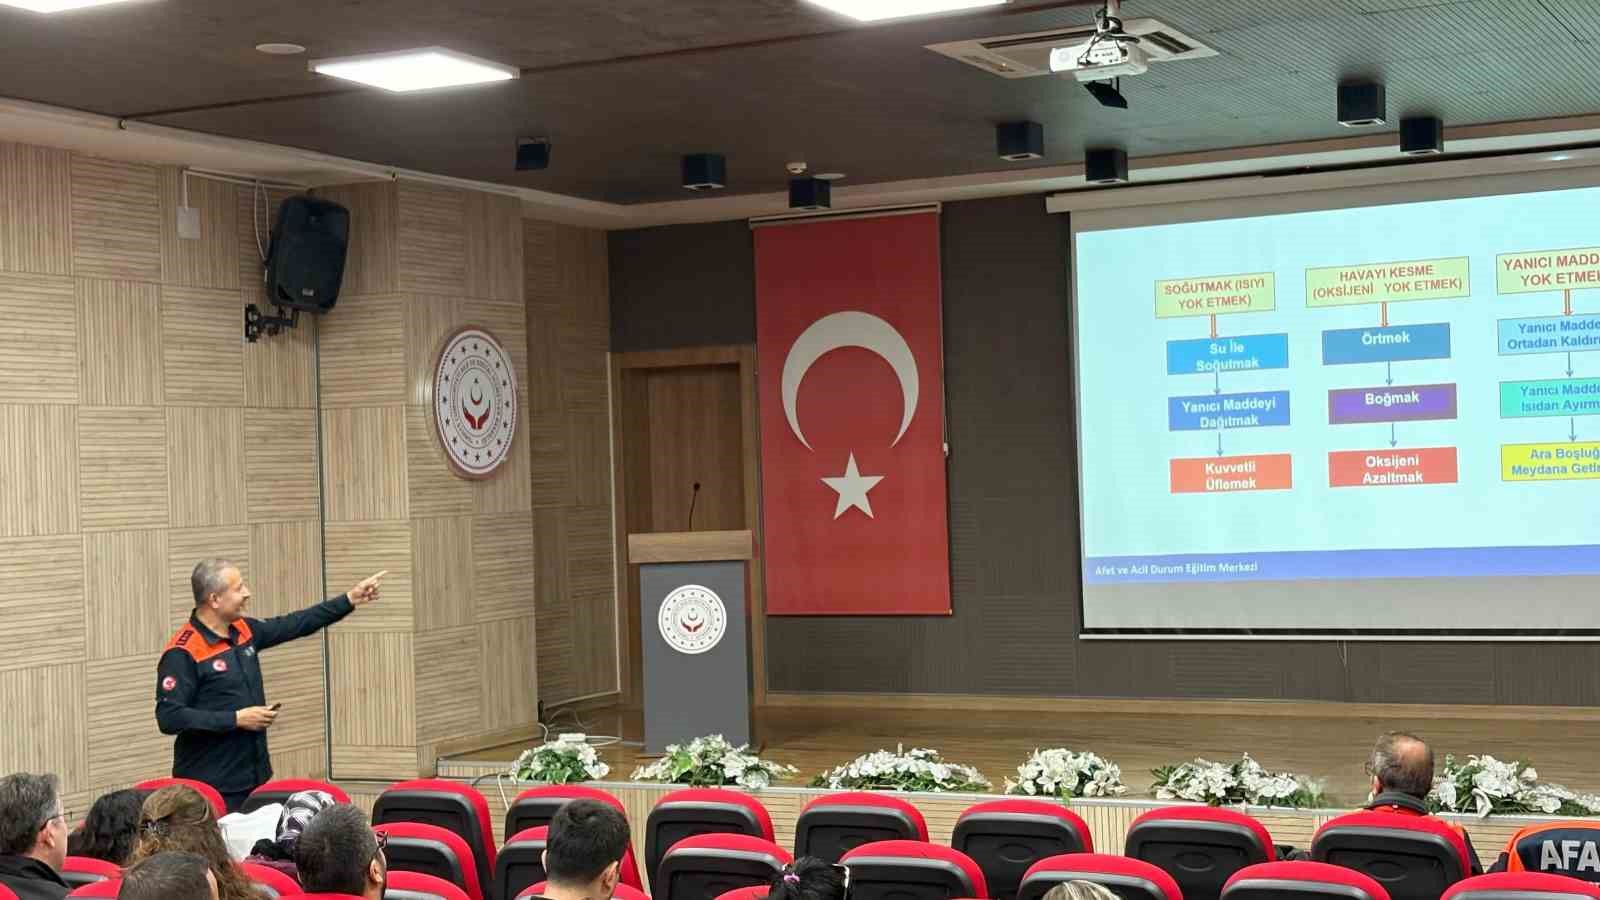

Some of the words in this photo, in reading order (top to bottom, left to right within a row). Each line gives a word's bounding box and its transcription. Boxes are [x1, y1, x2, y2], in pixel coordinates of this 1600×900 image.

[1503, 257, 1552, 271] YANICI
[1340, 268, 1386, 282] HAVAYI
[1389, 264, 1434, 278] KESME
[1521, 273, 1552, 287] YOK
[1164, 280, 1232, 295] SOĞUTMAK
[1235, 278, 1265, 292] (ISIYI
[1312, 283, 1374, 300] (OKSİJENİ
[1384, 281, 1411, 294] YOK
[1414, 277, 1463, 291] ETMEK)
[1178, 299, 1202, 310] YOK
[1206, 294, 1251, 308] ETMEK)
[1518, 323, 1556, 334] Yanıcı
[1361, 331, 1411, 345] Örtmek
[1507, 338, 1557, 350] Ortadan
[1209, 343, 1227, 355] Su
[1520, 385, 1559, 397] Yanıcı
[1182, 401, 1220, 414] Yanıcı
[1223, 396, 1276, 411] Maddeyi
[1365, 391, 1420, 407] Boğmak
[1521, 401, 1559, 412] Isıdan
[1530, 449, 1552, 460] Ara
[1205, 461, 1257, 475] Kuvvetli
[1365, 454, 1420, 470] Oksijeni
[1511, 464, 1568, 477] Meydana
[1205, 476, 1258, 491] Üflemek
[1362, 471, 1424, 485] Azaltmak
[1095, 564, 1115, 576] Afet
[1118, 566, 1128, 576] ve
[1130, 563, 1148, 575] Acil
[1151, 563, 1184, 575] Durum
[1185, 561, 1216, 576] Eğitim
[1218, 560, 1258, 573] Merkezi
[1541, 839, 1600, 872] AFA
